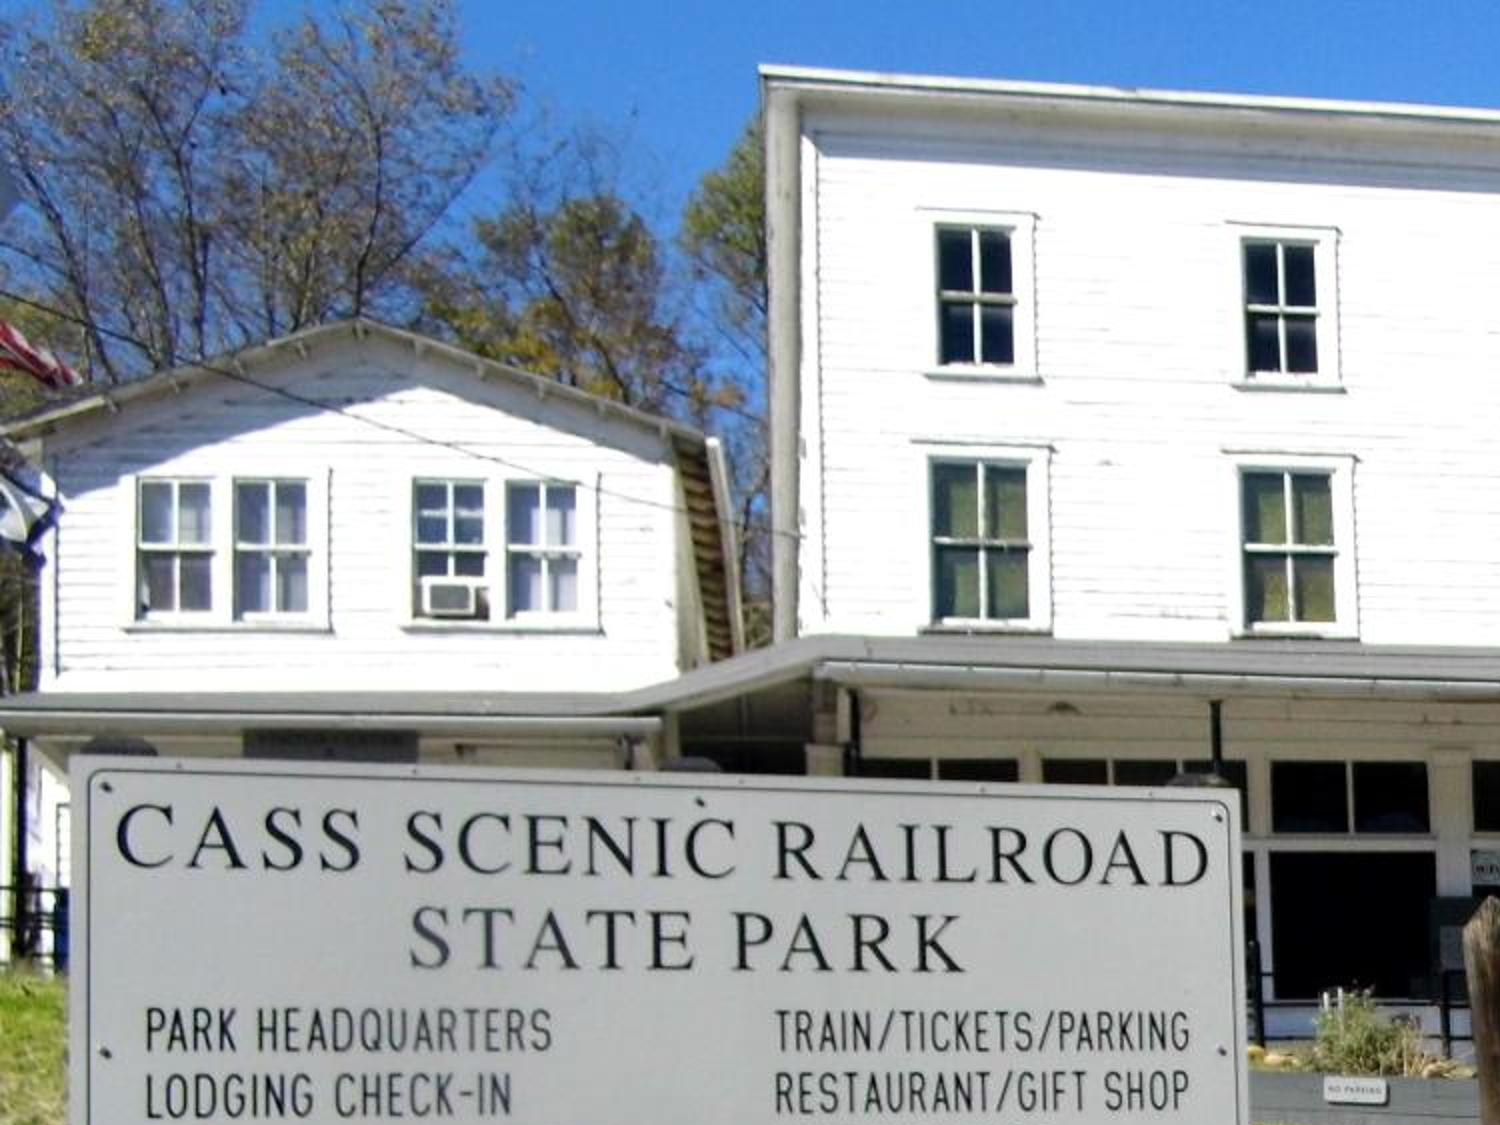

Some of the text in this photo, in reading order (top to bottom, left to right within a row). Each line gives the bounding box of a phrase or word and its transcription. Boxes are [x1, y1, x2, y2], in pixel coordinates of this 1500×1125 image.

[115, 803, 1209, 887] CASS SCENIC RAILROAD
[409, 905, 967, 974] STATE PARK
[145, 1006, 552, 1053] PARK HEADQUARTERS
[145, 1072, 512, 1120] LODGING CHECK-IN
[1103, 1069, 1189, 1112] SHOP
